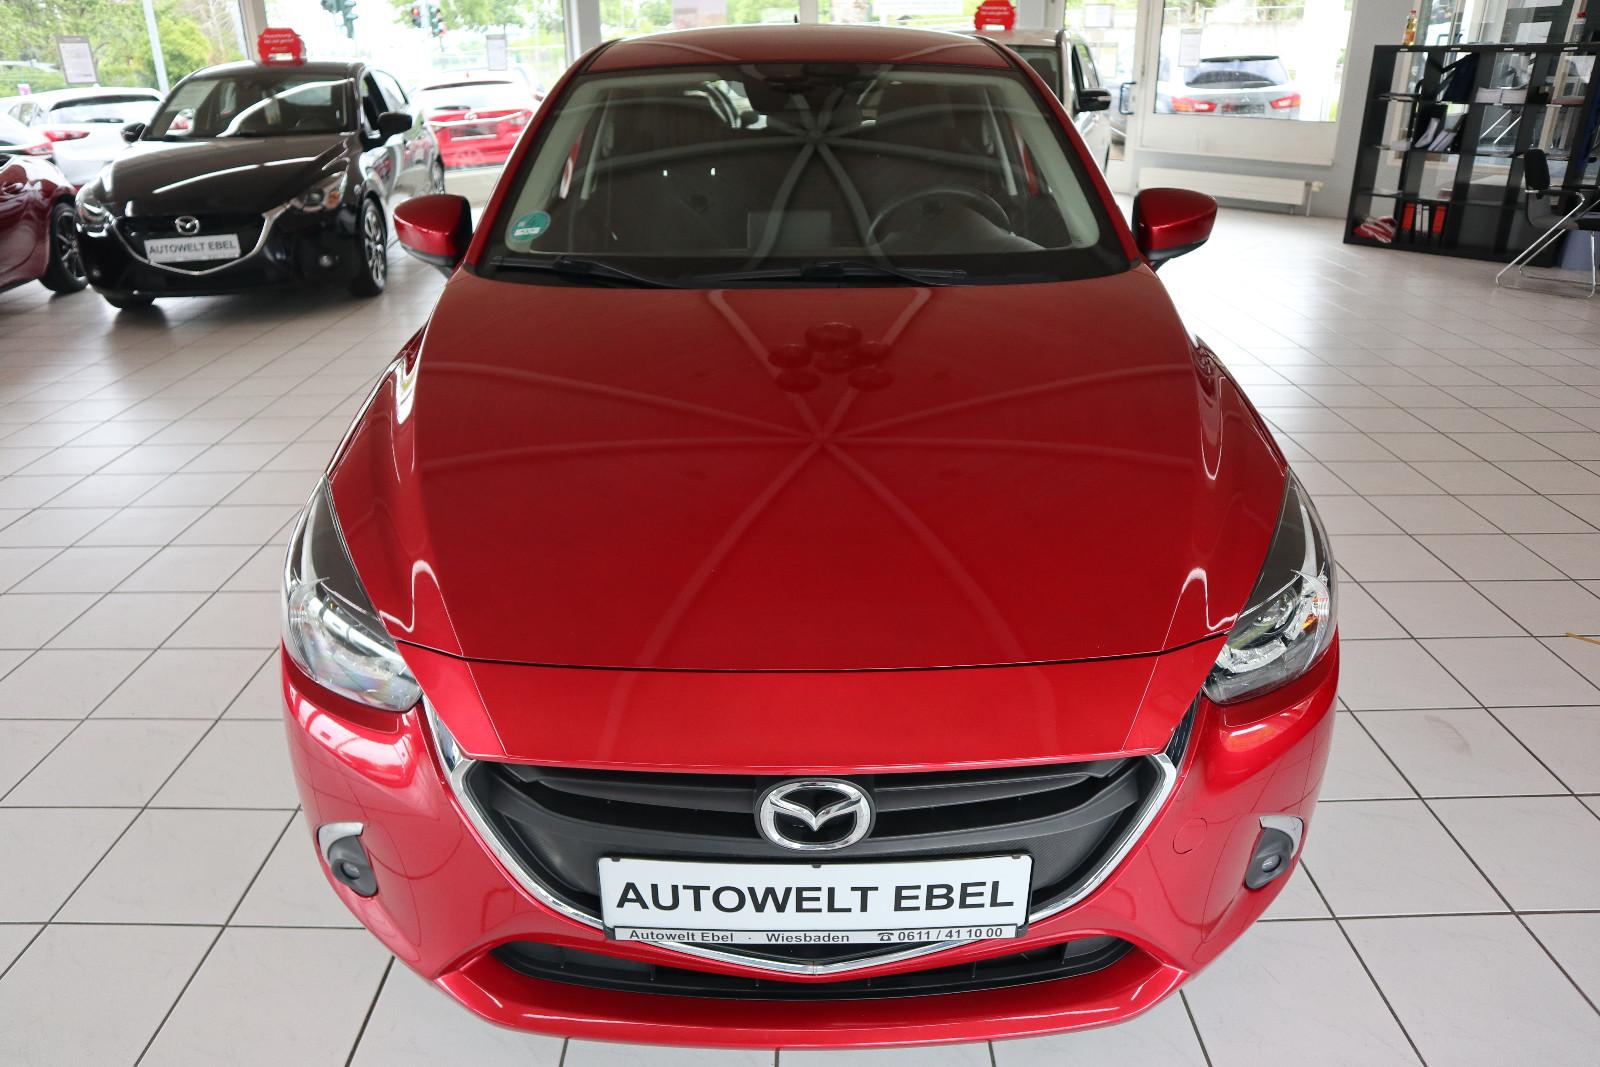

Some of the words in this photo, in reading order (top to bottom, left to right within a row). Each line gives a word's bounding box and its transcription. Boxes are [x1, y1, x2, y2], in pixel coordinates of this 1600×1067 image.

[149, 241, 205, 254] AUTOWELT
[208, 240, 236, 250] EBEL
[616, 882, 879, 913] AUTOWELT
[894, 880, 1014, 912] EBEL
[629, 930, 695, 942] Autowelt
[701, 932, 734, 943] Ebel
[766, 933, 850, 944] Wiesbaden
[898, 931, 930, 941] 0611
[945, 929, 961, 940] 41
[966, 928, 982, 938] 10
[986, 927, 1003, 938] 00
